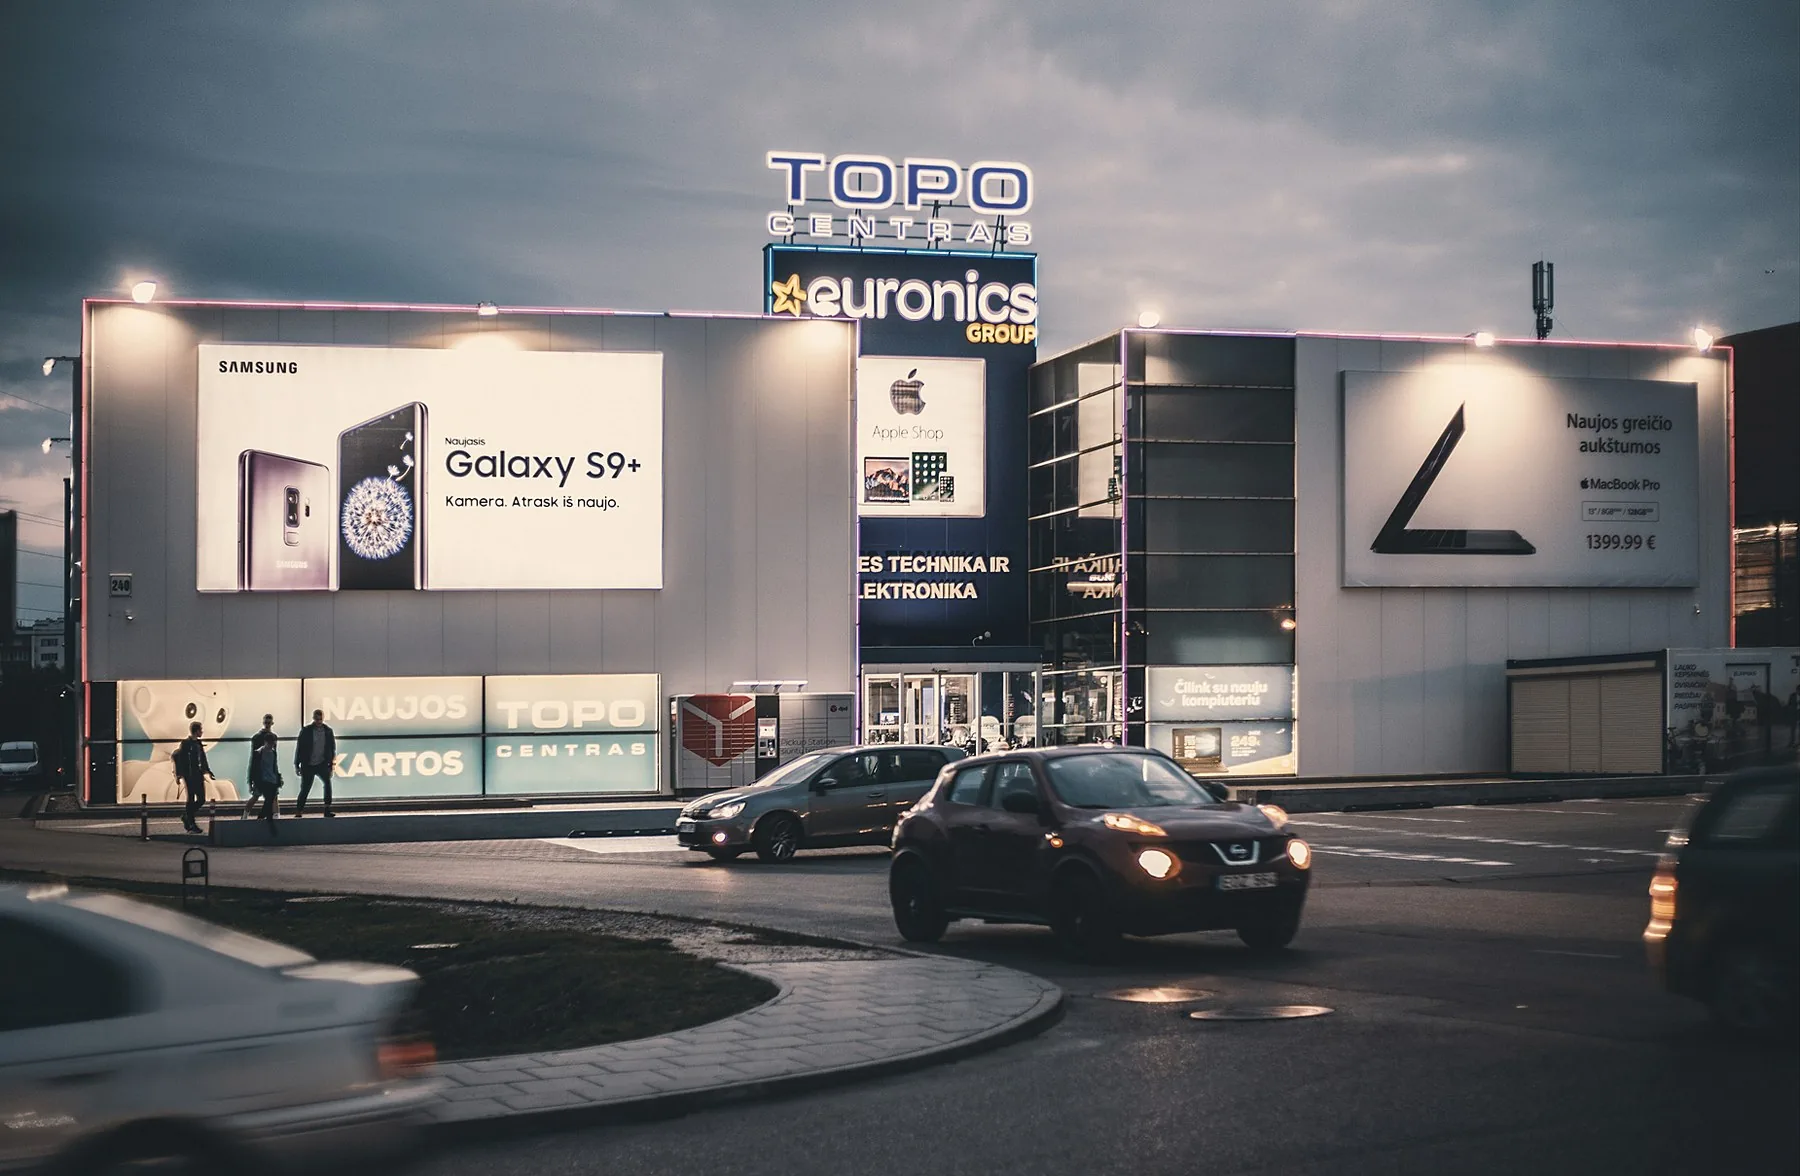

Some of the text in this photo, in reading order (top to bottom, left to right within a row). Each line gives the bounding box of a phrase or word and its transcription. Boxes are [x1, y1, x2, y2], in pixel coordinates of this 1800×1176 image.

[766, 151, 1034, 215] TOPO
[767, 212, 1033, 246] CENTRAS
[807, 270, 1037, 324] euronics
[966, 322, 1037, 345] GROUP
[218, 360, 298, 374] SAMSUNG
[1567, 413, 1673, 434] Naujos greičio
[872, 425, 945, 442] Apple Shop
[445, 437, 486, 448] Naujasis
[1580, 437, 1661, 454] aukštumos
[445, 450, 641, 488] Galaxy S9+
[1590, 479, 1661, 490] MacBook Pro
[445, 496, 621, 512] Kamera. Atrask iš naujo.
[1586, 534, 1657, 550] 1399.99 €
[887, 556, 987, 573] TECHNIKA
[989, 556, 1010, 573] IR
[112, 579, 130, 592] 240
[1174, 678, 1268, 696] Čilink su nauju
[322, 695, 468, 721] NAUJOS
[1181, 694, 1261, 709] kompiuteriu
[496, 700, 646, 729] TOPO
[496, 743, 646, 758] CENTRAS
[781, 737, 836, 748] Pickup Station
[334, 750, 463, 777] KARTOS
